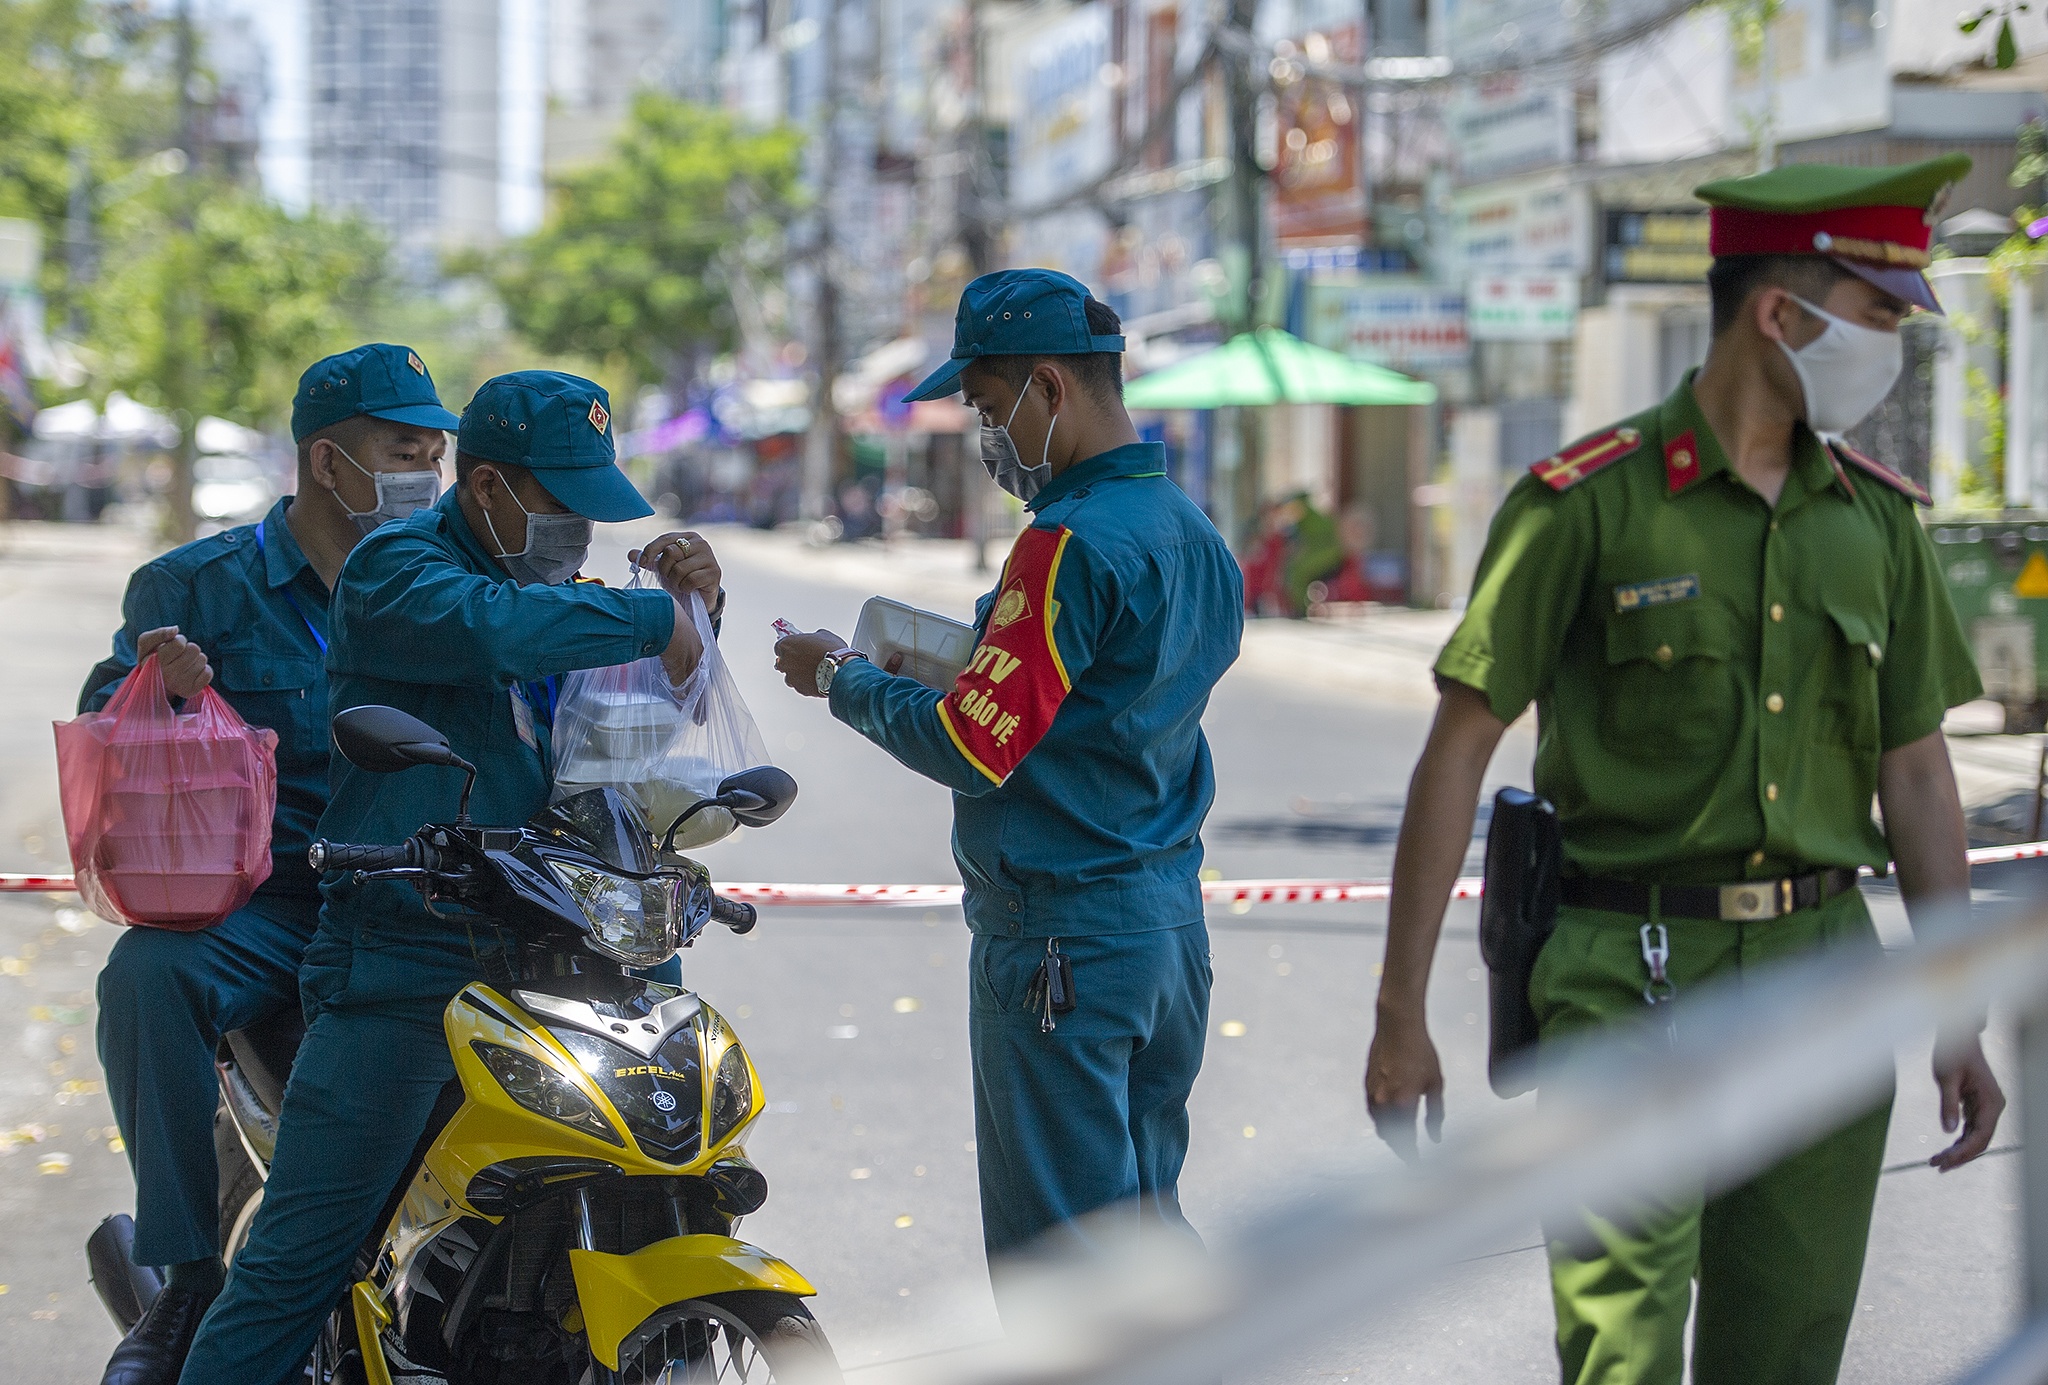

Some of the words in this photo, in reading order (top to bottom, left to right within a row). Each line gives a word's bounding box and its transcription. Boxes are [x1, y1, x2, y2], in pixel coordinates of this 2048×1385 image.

[959, 689, 999, 727] BẢO
[990, 711, 1021, 748] VỆ
[615, 1065, 668, 1078] EXCEL
